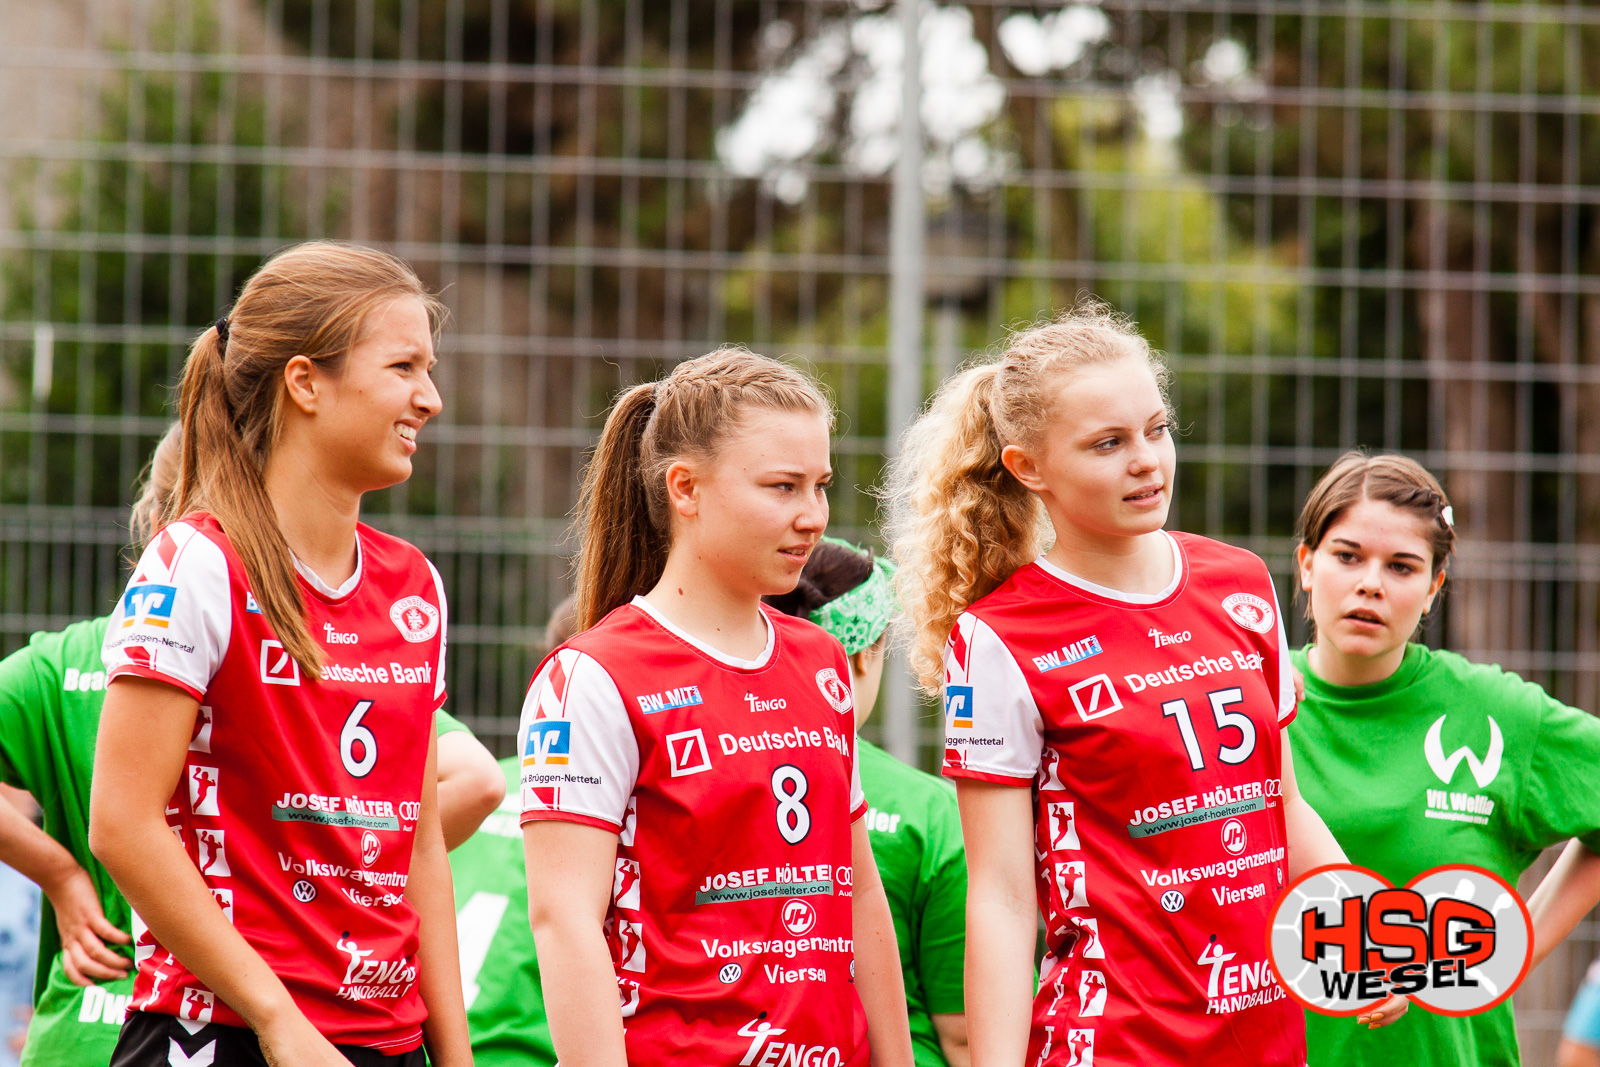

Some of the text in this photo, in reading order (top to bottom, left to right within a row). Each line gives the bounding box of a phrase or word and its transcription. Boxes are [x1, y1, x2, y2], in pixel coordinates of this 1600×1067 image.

[323, 621, 359, 644] TENGO
[1148, 627, 1192, 648] TENGO
[1032, 637, 1094, 672] BW MIT
[63, 667, 108, 692] Bea
[320, 662, 389, 683] eutsche
[1124, 656, 1233, 693] Deutsche
[637, 686, 696, 712] BW MIT
[744, 691, 787, 712] TENGO
[340, 699, 378, 778] 6
[718, 726, 822, 755] Deutsche
[1160, 686, 1257, 772] 15
[528, 773, 602, 785] Brüggen-Nettetal
[277, 793, 394, 818] JOSEF HÖLTER
[771, 763, 811, 845] 8
[1130, 782, 1262, 826] JOSEF HÖLTER
[1144, 802, 1257, 835] www.josef-hoelter.com
[700, 868, 769, 893] JOSEF
[1211, 883, 1266, 907] Viersen
[764, 964, 826, 984] Viersen
[1197, 942, 1277, 998] TENG
